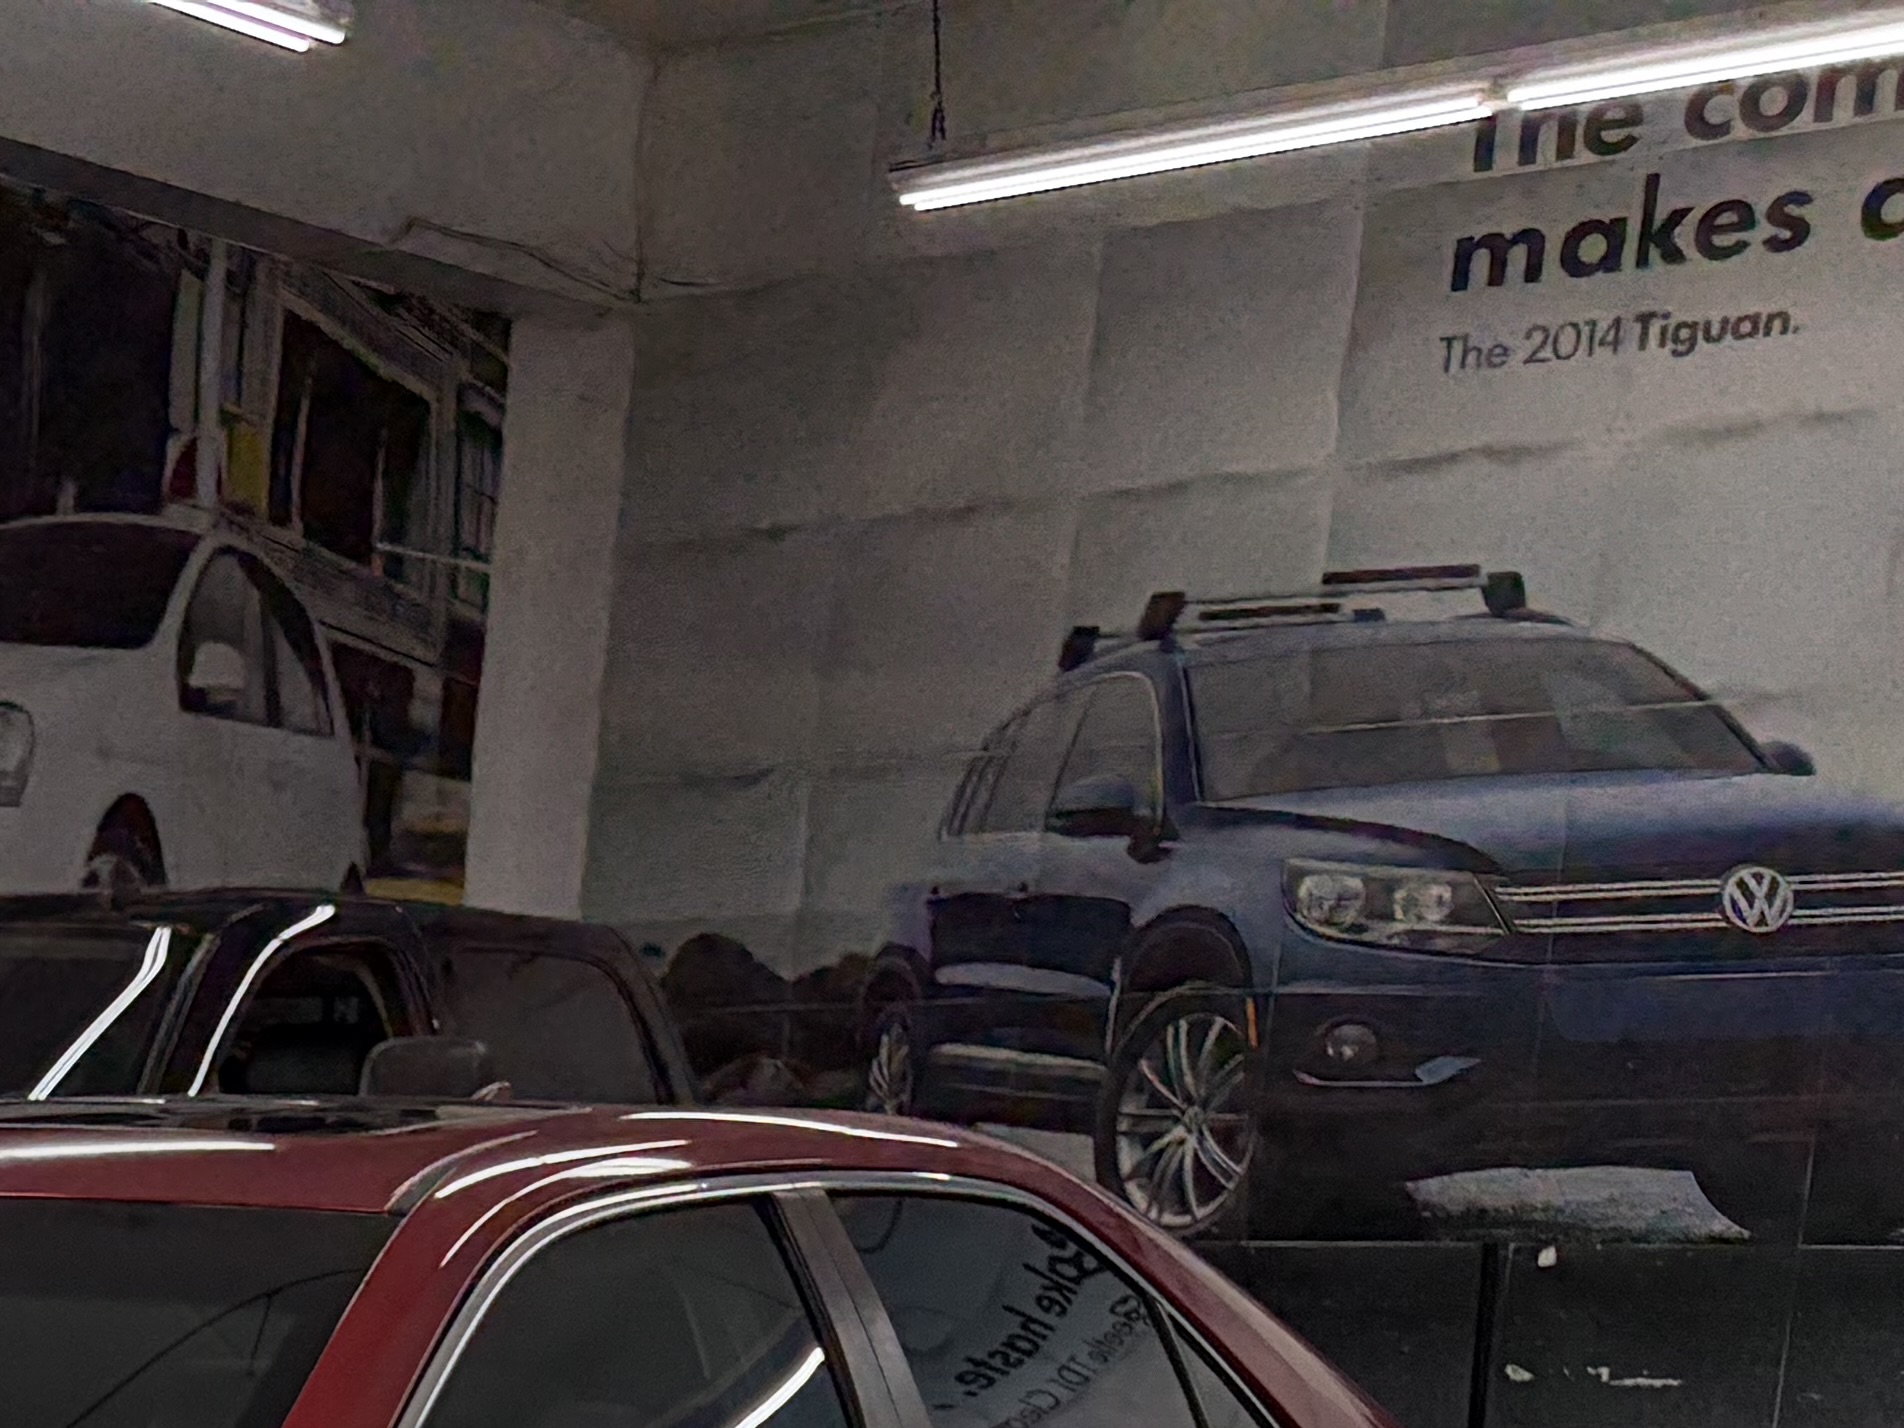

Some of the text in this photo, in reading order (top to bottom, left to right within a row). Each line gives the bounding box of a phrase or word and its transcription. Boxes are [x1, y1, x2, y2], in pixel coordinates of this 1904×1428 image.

[1450, 173, 1815, 292] makes
[1439, 309, 1801, 373] The 2014 Tiguan.
